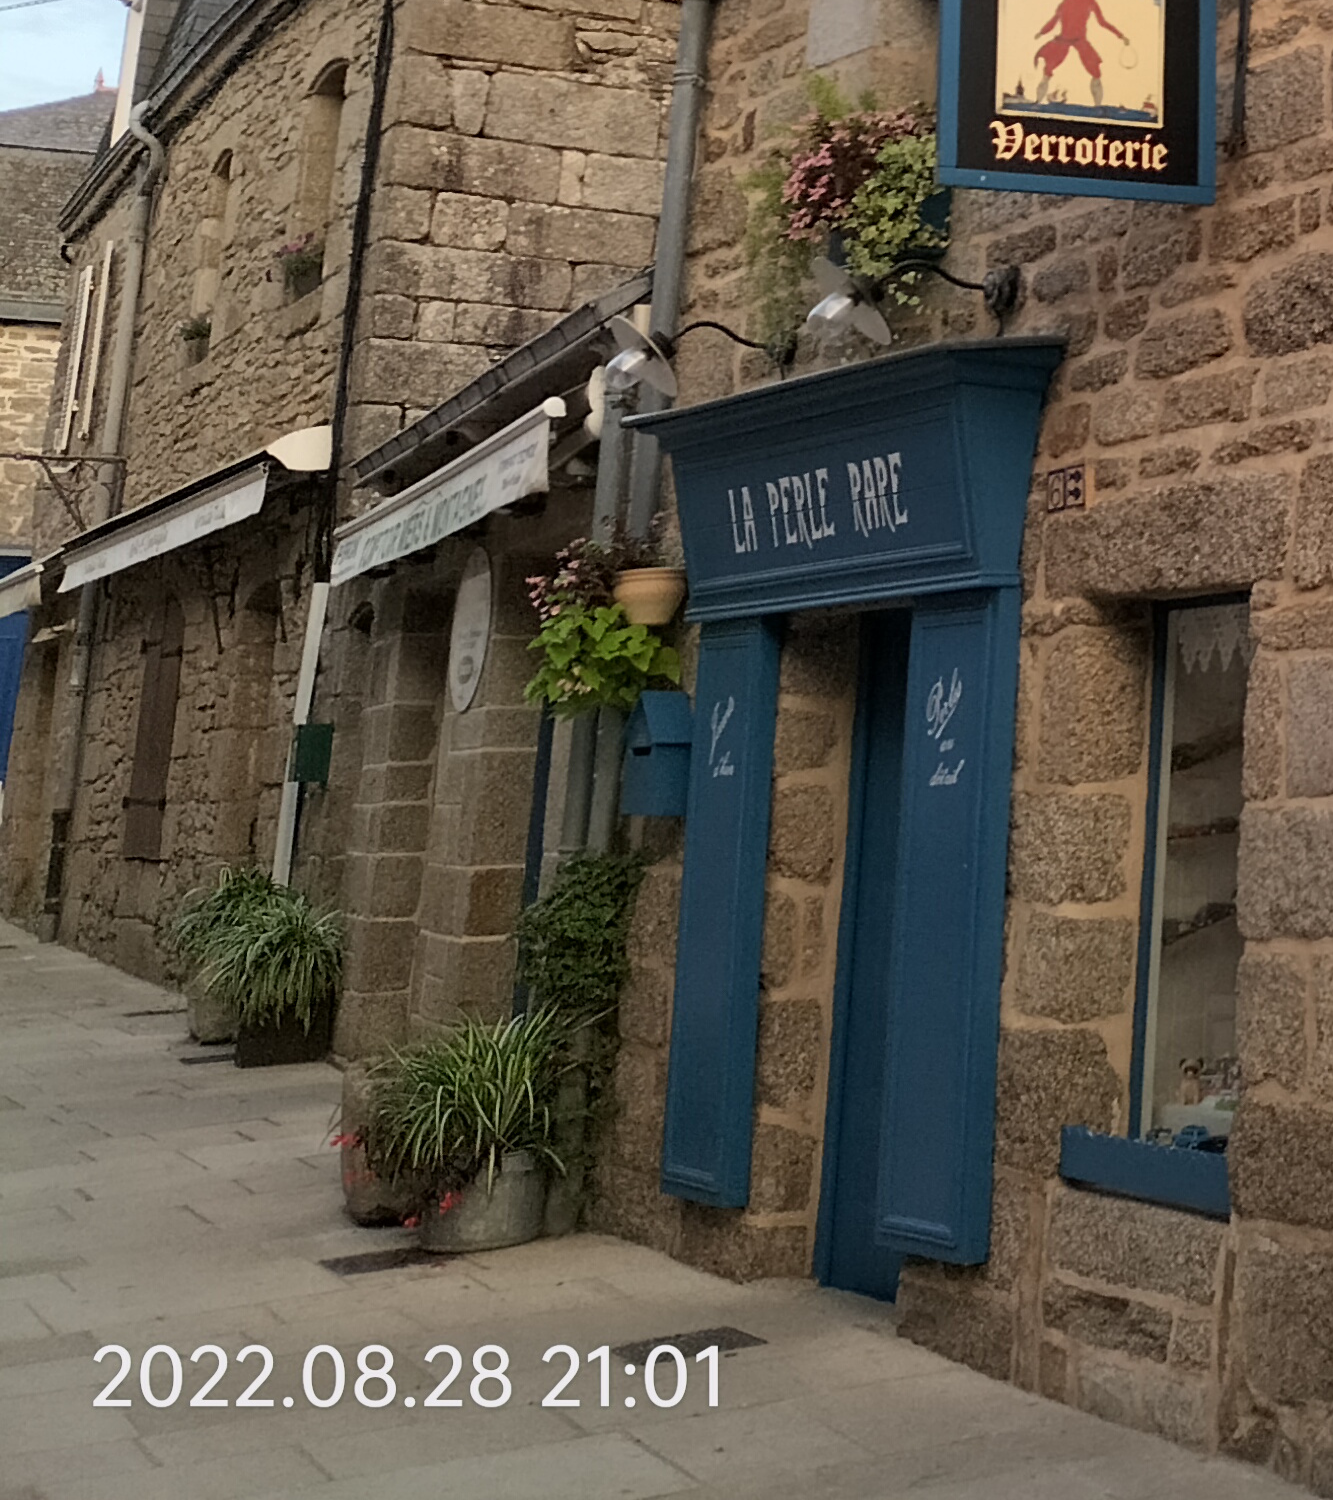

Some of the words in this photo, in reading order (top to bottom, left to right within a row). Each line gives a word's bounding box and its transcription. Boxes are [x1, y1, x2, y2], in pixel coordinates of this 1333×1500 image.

[989, 120, 1169, 171] Verroterie
[728, 486, 758, 553] LA
[766, 467, 836, 550] PERLE
[847, 452, 909, 539] RARE
[1050, 475, 1061, 507] 6
